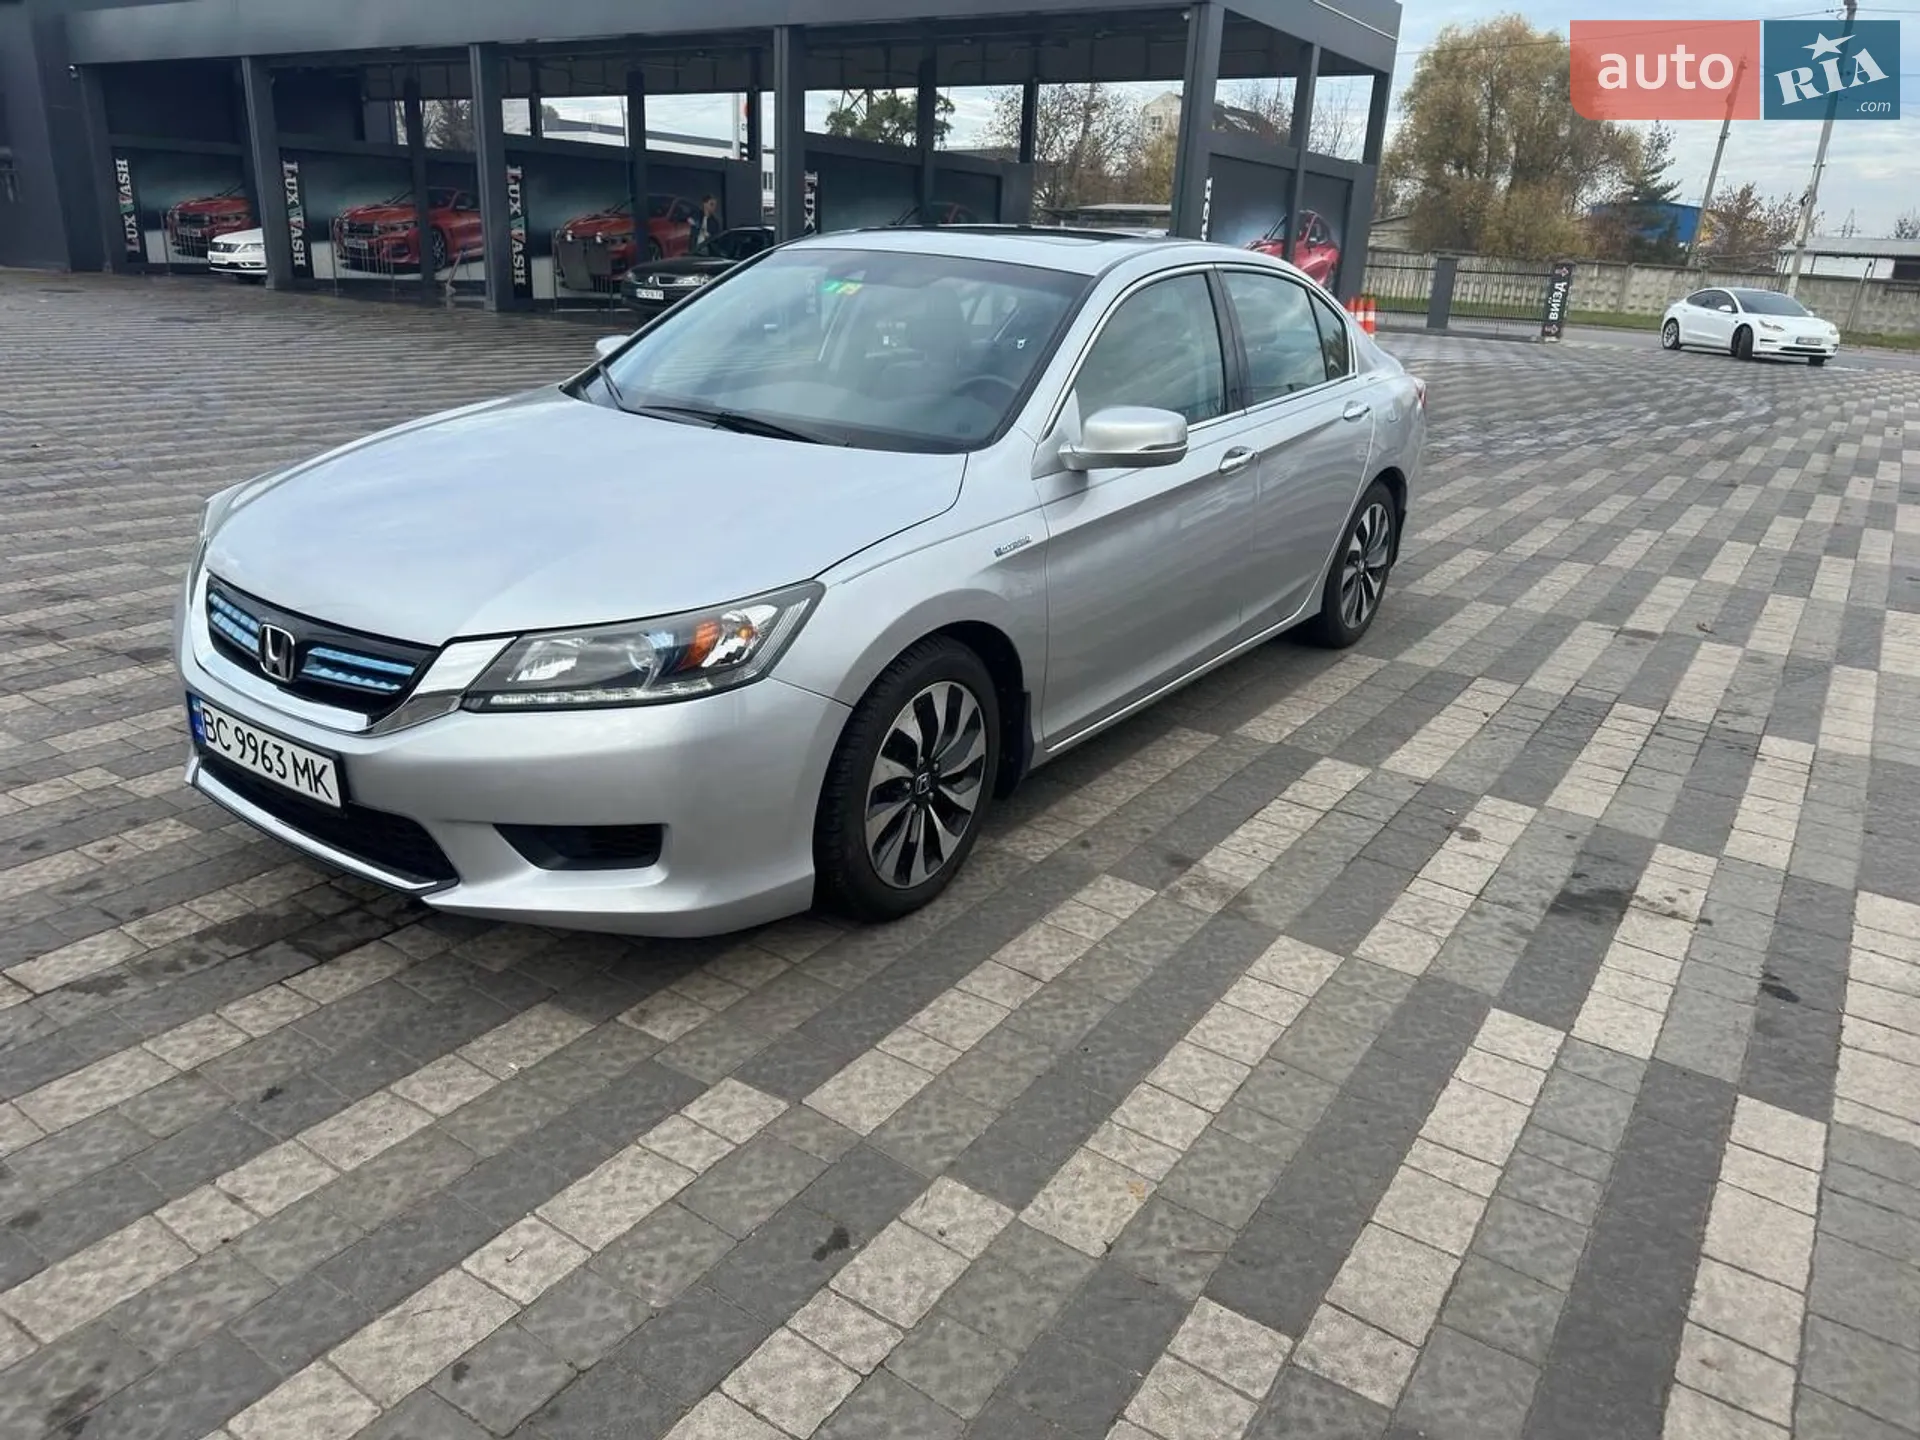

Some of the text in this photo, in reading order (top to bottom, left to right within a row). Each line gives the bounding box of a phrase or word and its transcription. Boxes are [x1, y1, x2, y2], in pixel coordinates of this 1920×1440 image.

[1548, 282, 1568, 320] ВИЇЗД
[202, 708, 333, 800] BC 9963 MK
